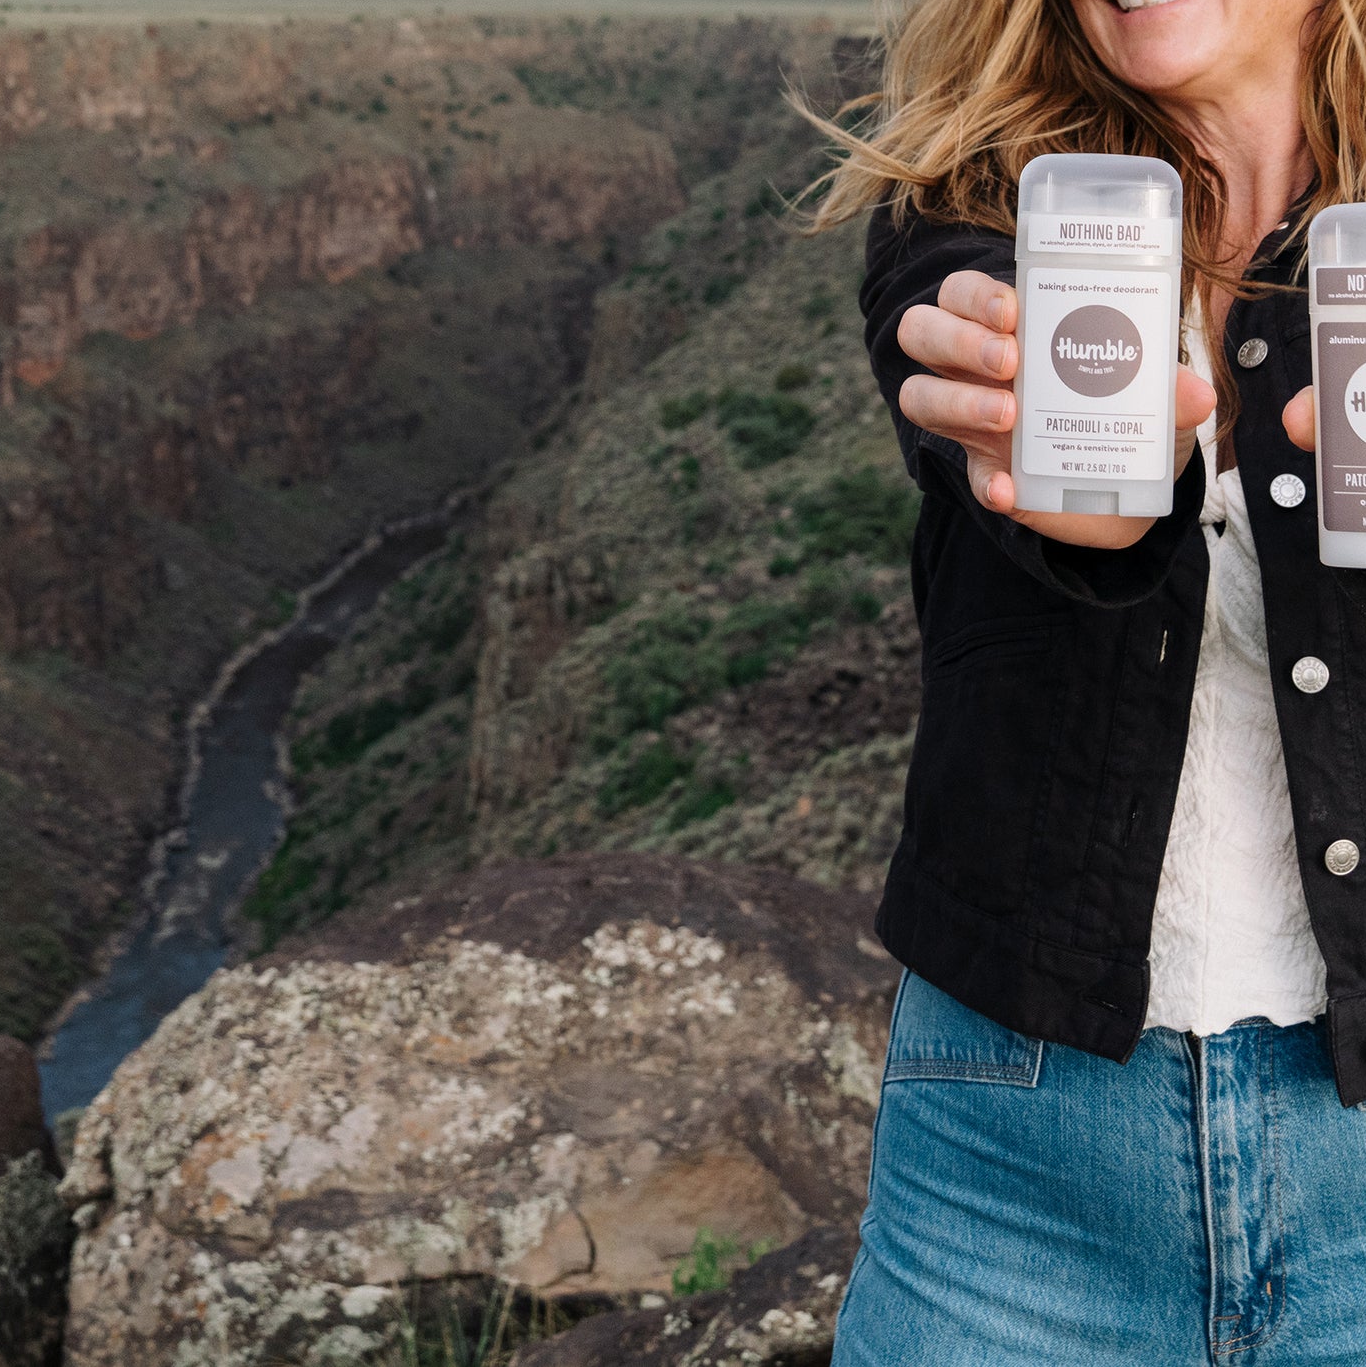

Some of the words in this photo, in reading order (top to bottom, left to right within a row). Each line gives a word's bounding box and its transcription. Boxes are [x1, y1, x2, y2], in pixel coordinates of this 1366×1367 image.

[1060, 223, 1113, 240] NOTHING
[1038, 282, 1066, 292] baking
[1068, 284, 1111, 292] soda-free
[1113, 285, 1159, 294] deodorant
[1056, 337, 1138, 362] Humble
[1046, 418, 1100, 433] PATCHOULI
[1104, 424, 1110, 432] &
[1113, 422, 1144, 435] COPAL
[1052, 444, 1074, 452] vegan
[1062, 462, 1073, 471] NET
[1074, 463, 1086, 472] WT.
[1087, 463, 1097, 472] 2.5
[1098, 464, 1106, 473] OZ
[1112, 464, 1121, 473] 70
[1122, 464, 1127, 473] G
